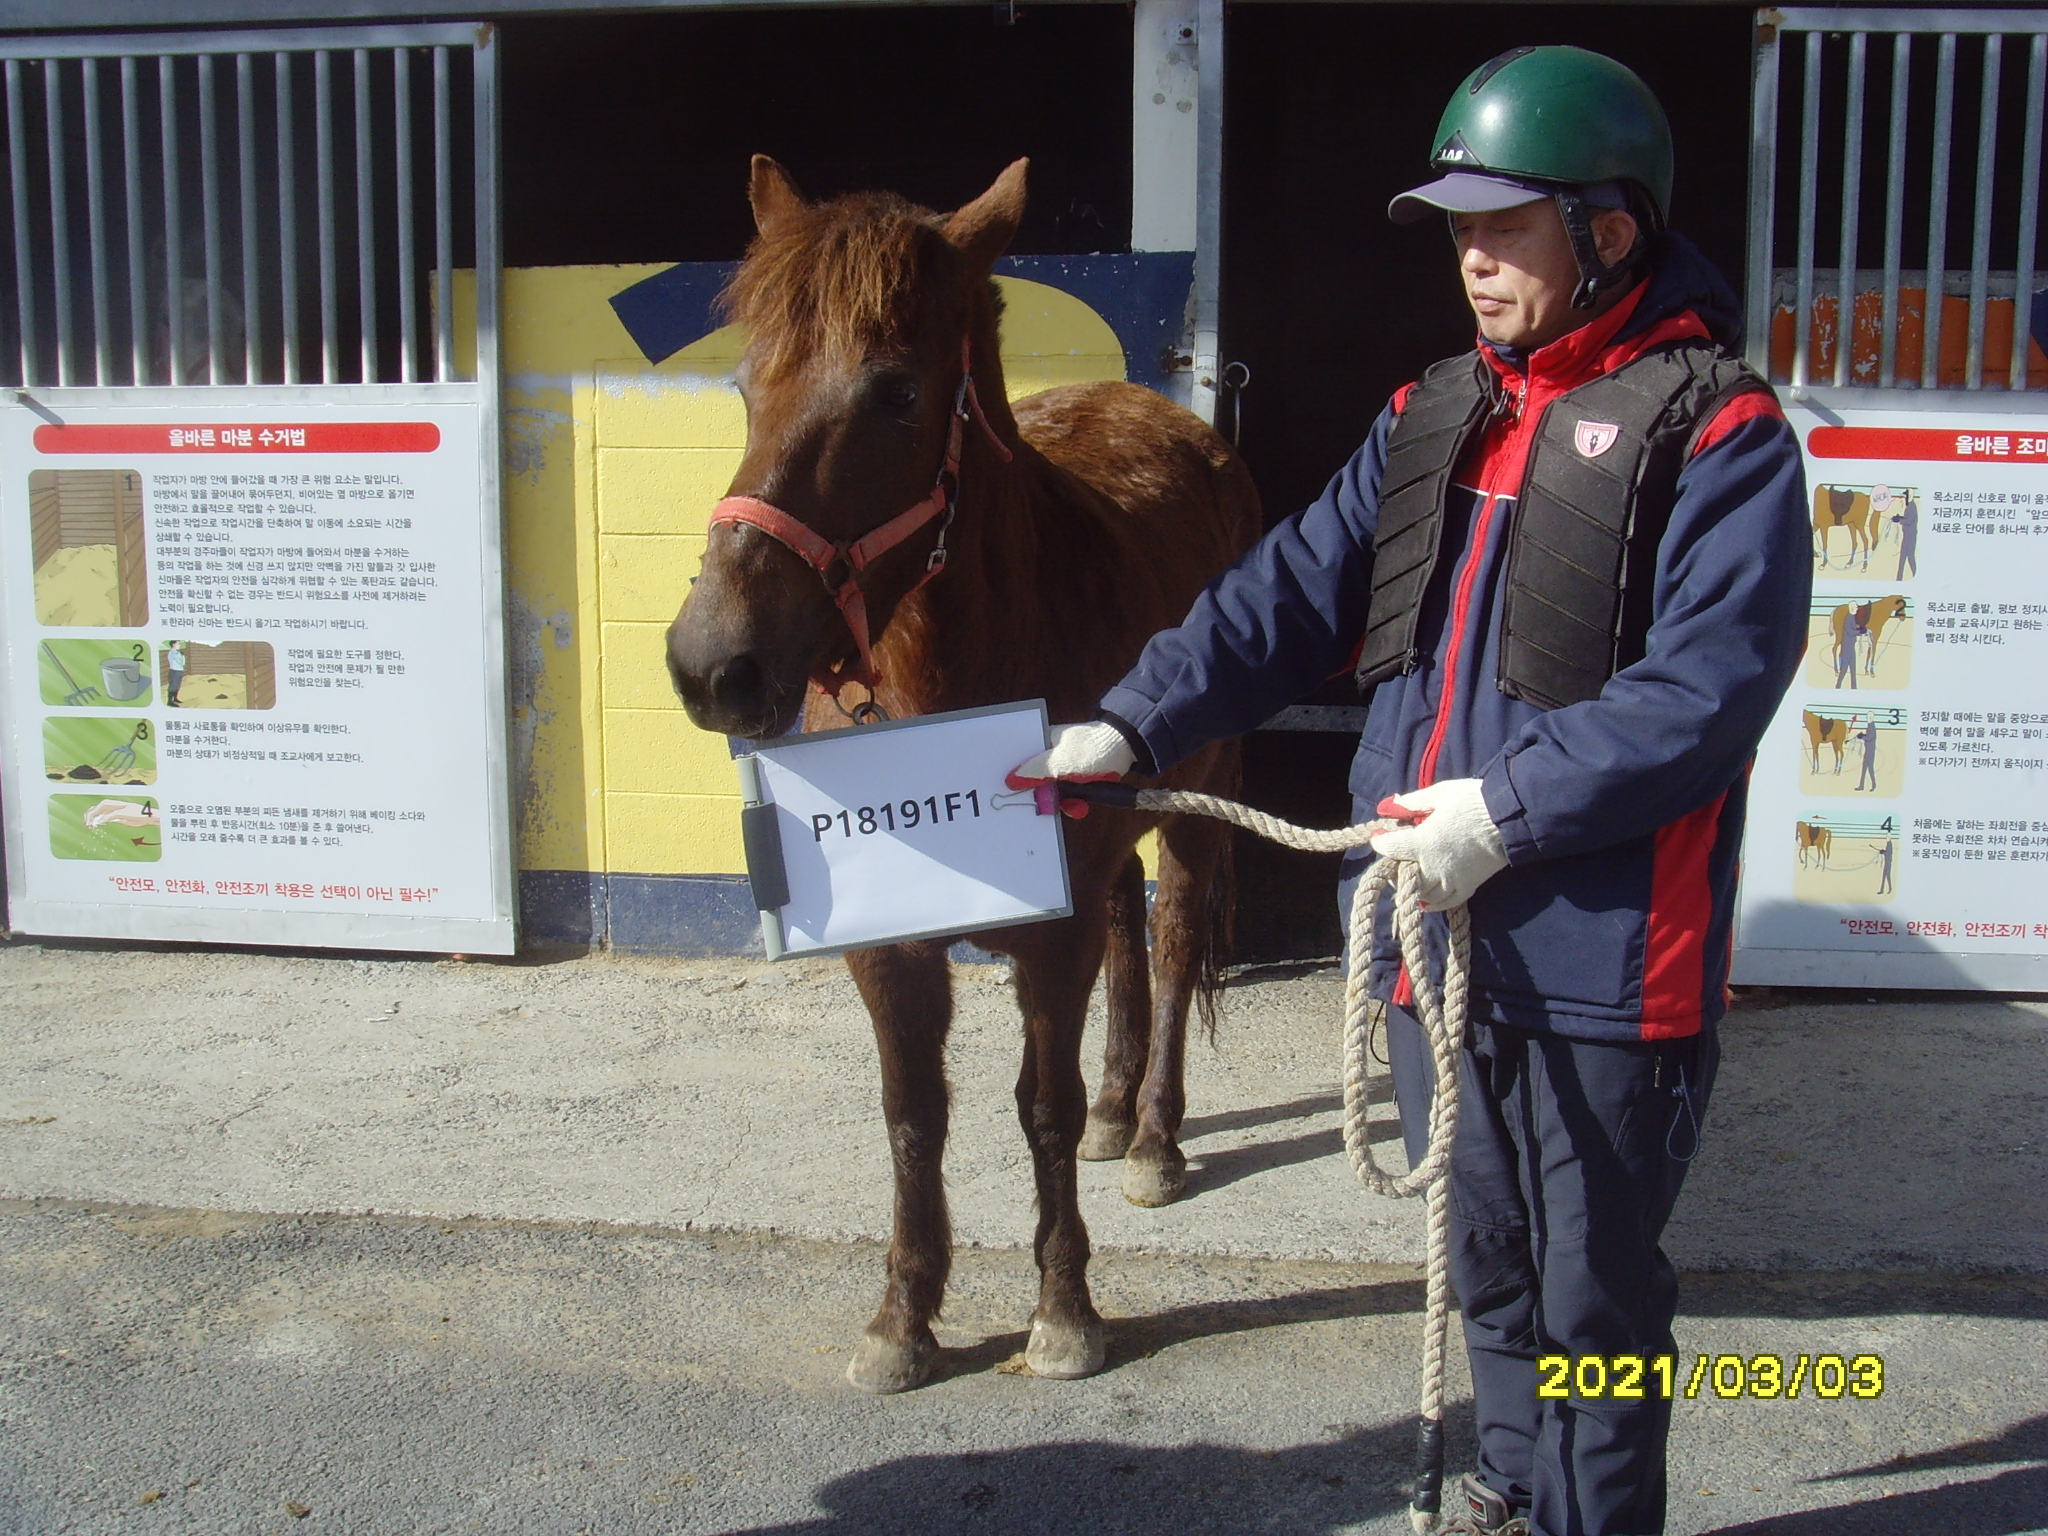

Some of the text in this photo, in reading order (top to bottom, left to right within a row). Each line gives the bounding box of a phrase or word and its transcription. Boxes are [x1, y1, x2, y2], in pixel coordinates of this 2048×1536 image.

[169, 429, 305, 446] 올바른 마분 수거법
[1956, 435, 2010, 455] 올바른
[125, 474, 132, 491] 1
[153, 475, 403, 485] 작업자가 마방 안에 가장 위험 요소는 말입니다.
[154, 489, 385, 499] 마방에서 말을 비어있는 마방으로
[1902, 488, 1909, 506] 1
[1934, 492, 2030, 504] 목소리의 신호로 말이
[154, 504, 316, 513] 안전하고 작업할 있습니다.
[1933, 507, 2016, 519] 지금까지 훈련시킨
[155, 518, 411, 528] 신속한 작업으로 작업시간을 이동에 소요되는 시간을
[1932, 523, 2028, 535] 새로운 단어를 하나씩
[196, 533, 233, 542] 있습니다.
[157, 547, 409, 557] 대부분의 작업자가 마방에 마분을 수거하는
[157, 561, 435, 572] 등의 작업을 하는 것에 신경 쓰지 않지만 가진 입사한
[195, 575, 438, 587] 작업자의 안전을 심각하게 있는 같습니다.
[159, 589, 426, 601] 안전을 없는 경우는 반드시 위험요소를 사전에 제거하려는
[160, 604, 233, 613] 노력이 필요합니다.
[1894, 598, 1906, 617] 2
[1928, 602, 2017, 614] 목소리로 출발, 평보
[198, 618, 368, 629] 신마는 반드시 작업하시기 바랍니다.
[1926, 618, 2042, 630] 속보를 교육시키고 원하는
[1926, 633, 2004, 644] 빨리 정착 시킨다.
[132, 644, 144, 662] 2
[288, 649, 404, 660] 작업에 필요한 도구를 정한다.
[288, 663, 405, 674] 작업과 안전에 문제가 만한
[289, 677, 364, 688] 위험요인을 찾는다.
[1888, 708, 1900, 726] 3
[1921, 711, 1950, 722] 정지할
[1954, 712, 1983, 722] 때에는
[1987, 713, 2006, 723] 말을
[136, 722, 148, 740] 3
[165, 721, 350, 734] 물통과 사료통을 확인하여 이상유무를 확인한다.
[1920, 727, 2042, 739] 벽에 말을 세우고 말이
[166, 735, 230, 745] 마분을 수거한다.
[1919, 741, 1993, 753] 있도록 가르친다.
[167, 749, 364, 762] 마분의 상태가 비정상적일 조교사에게 보고한다.
[1972, 758, 2043, 769] 전까지 움직이지
[141, 800, 152, 818] 4
[170, 805, 425, 821] 오줌으로 부분의 제거하기 위해 베이킹 소다와
[811, 788, 981, 843] P18191F1
[1881, 816, 1893, 832] 4
[1914, 819, 2027, 831] 처음에는 잘하는 좌회전을
[172, 832, 343, 846] 시간을 오래 효과를 있다.
[1912, 834, 2007, 845] 못하는 우회전은 차차
[1964, 850, 2006, 860] 둔한 말은
[109, 877, 438, 902] “안전모, 안전화, 안전조끼 착용은 선택이 아닌 필수!”
[1841, 919, 1898, 935] “안전모,
[1907, 921, 1956, 937] 안전화,
[1965, 923, 2026, 938] 안전조끼
